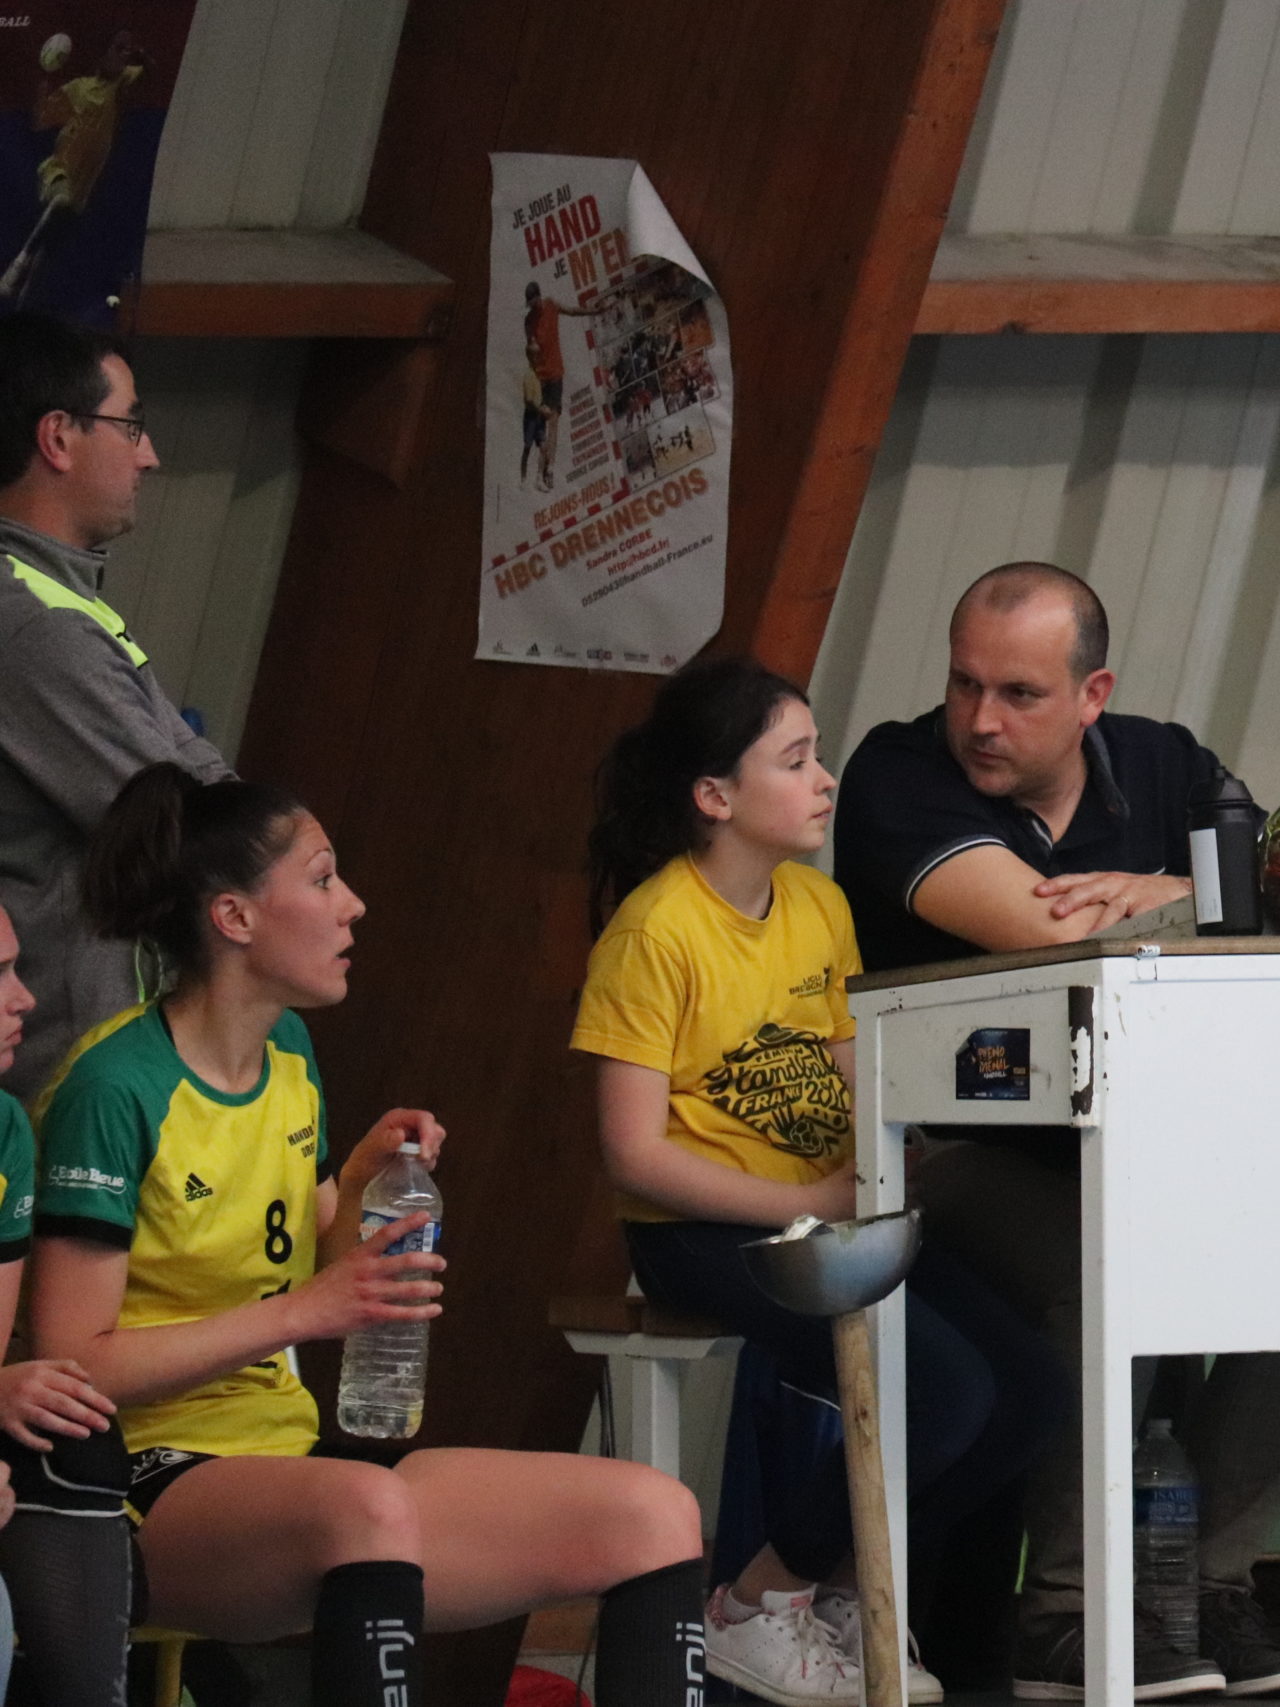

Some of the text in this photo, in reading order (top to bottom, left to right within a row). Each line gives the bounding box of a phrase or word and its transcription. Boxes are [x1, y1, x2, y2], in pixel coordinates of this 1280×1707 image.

[512, 183, 572, 230] JE JOUE AU
[523, 194, 602, 268] HAND
[553, 257, 569, 279] JE
[494, 467, 709, 600] HBC DRENNECOIS
[738, 1085, 803, 1116] FRANCE
[184, 1187, 214, 1203] didas
[264, 1200, 293, 1265] 8
